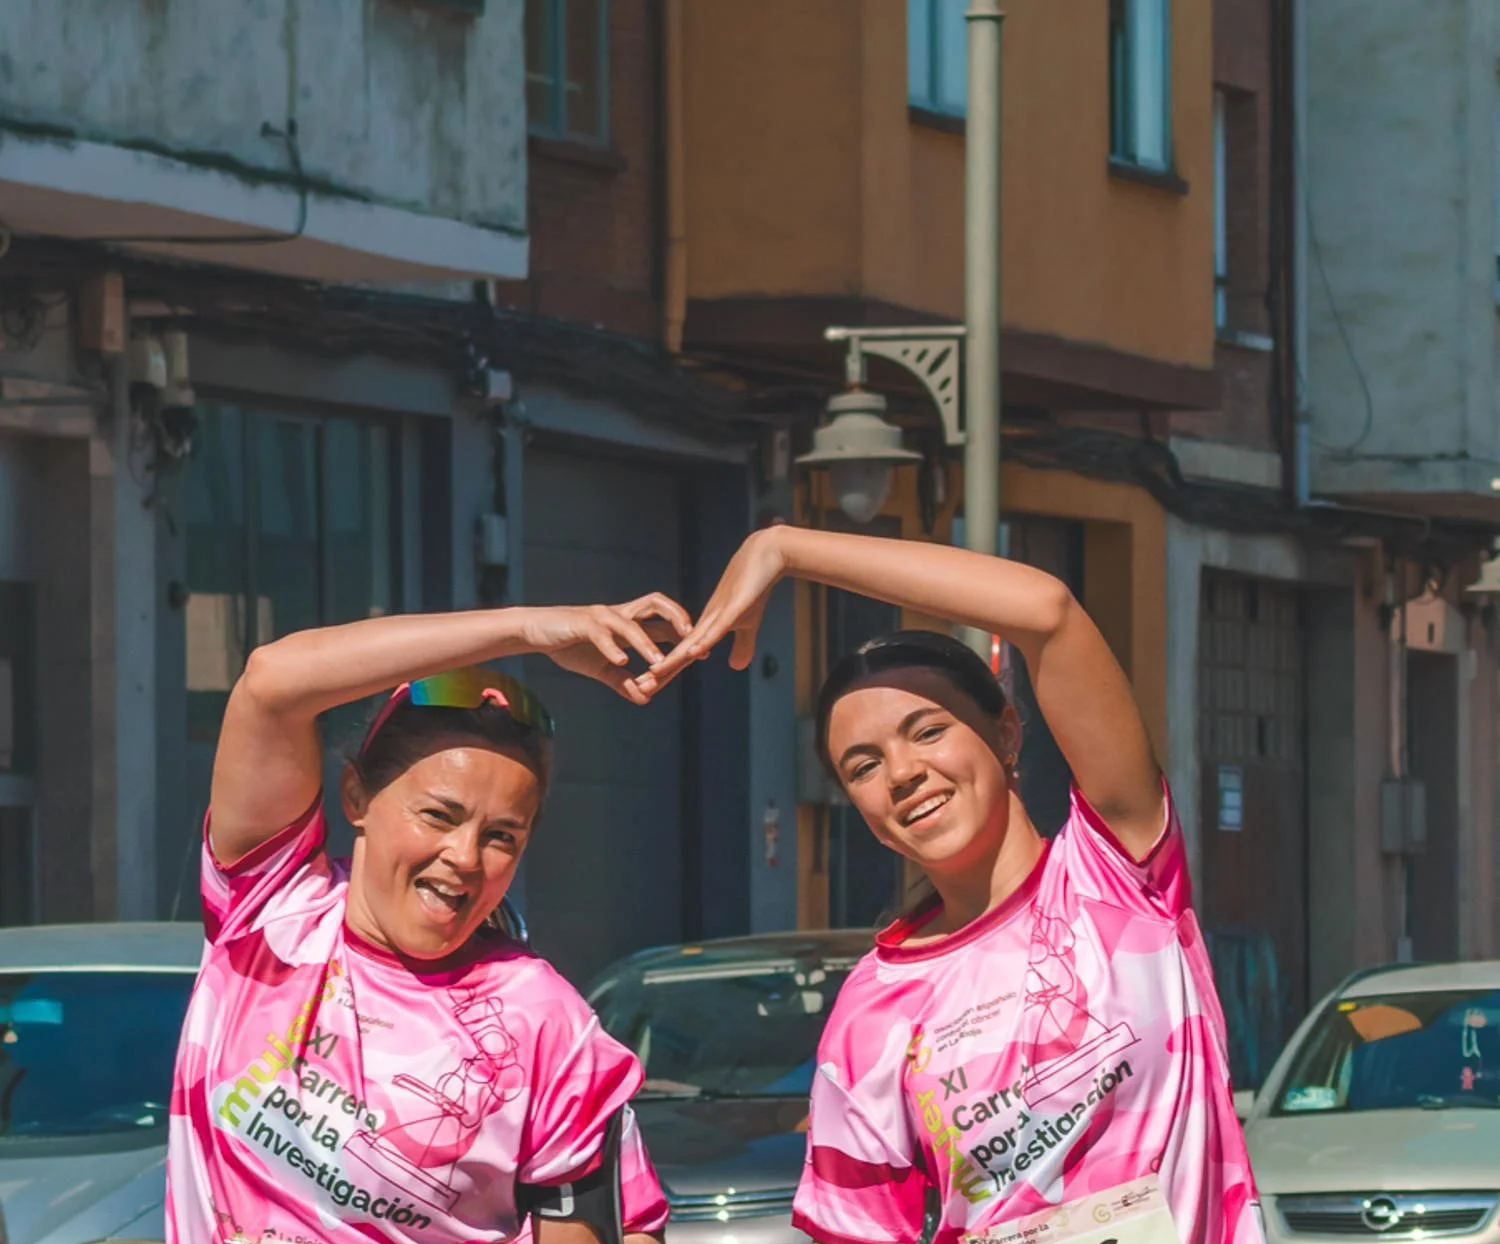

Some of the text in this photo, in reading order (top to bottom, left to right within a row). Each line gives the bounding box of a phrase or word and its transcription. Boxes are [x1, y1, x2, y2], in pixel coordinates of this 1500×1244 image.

[304, 1025, 339, 1059] XI
[939, 1066, 968, 1101] XI
[262, 1084, 341, 1151] por la
[971, 1127, 1016, 1169] por
[246, 1111, 432, 1231] Investigación
[1023, 1227, 1038, 1238] por
